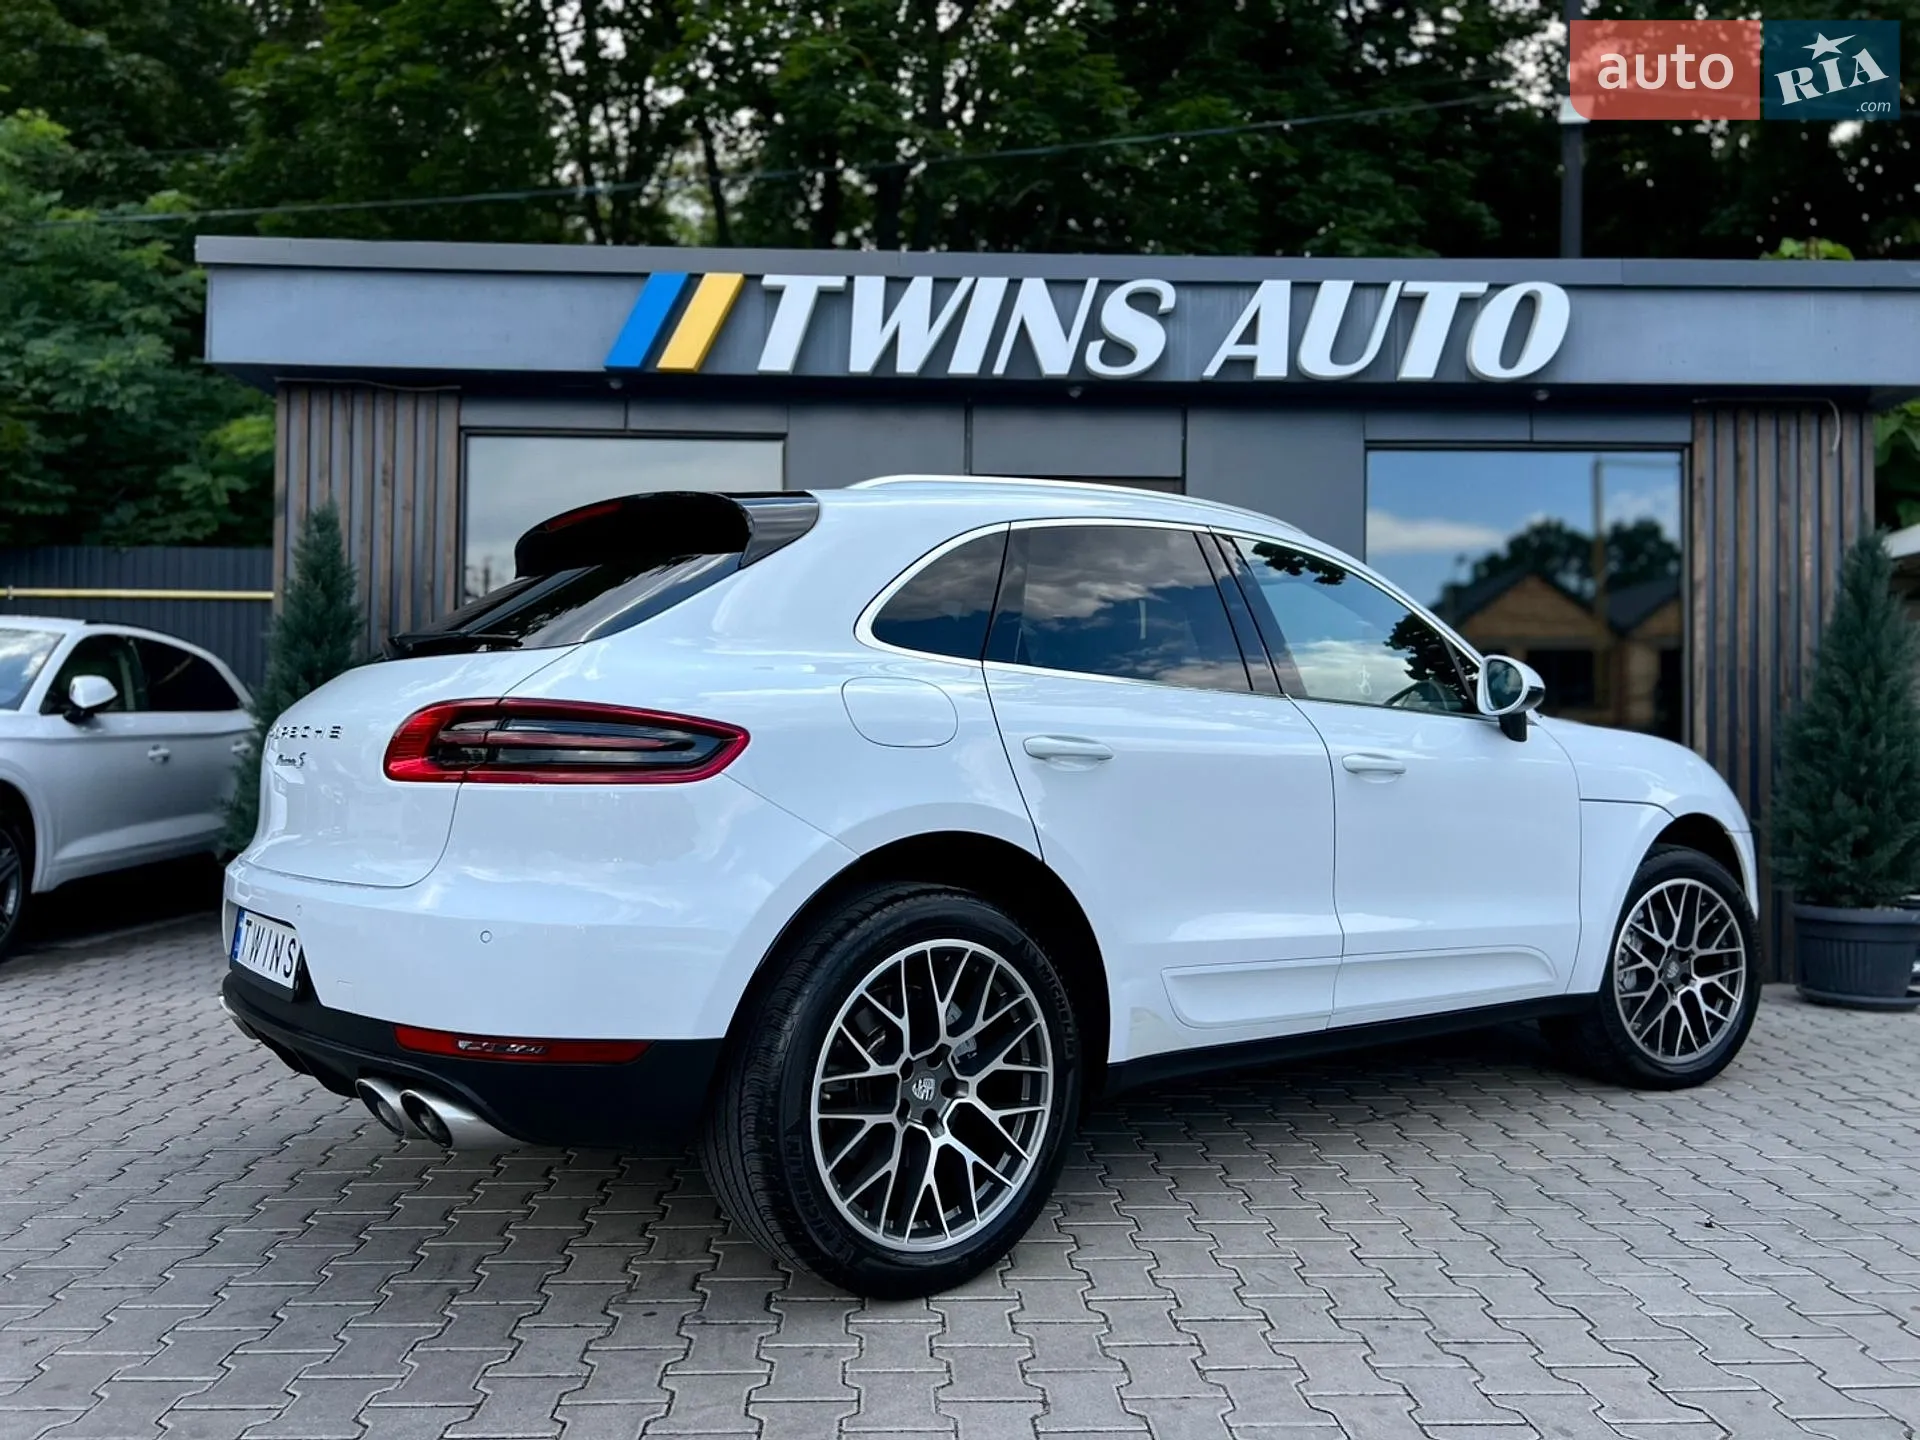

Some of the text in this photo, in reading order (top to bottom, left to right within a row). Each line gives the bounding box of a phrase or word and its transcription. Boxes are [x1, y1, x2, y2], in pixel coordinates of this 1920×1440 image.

[757, 273, 1571, 381] TWINS AUTO
[242, 919, 297, 979] TWINS
